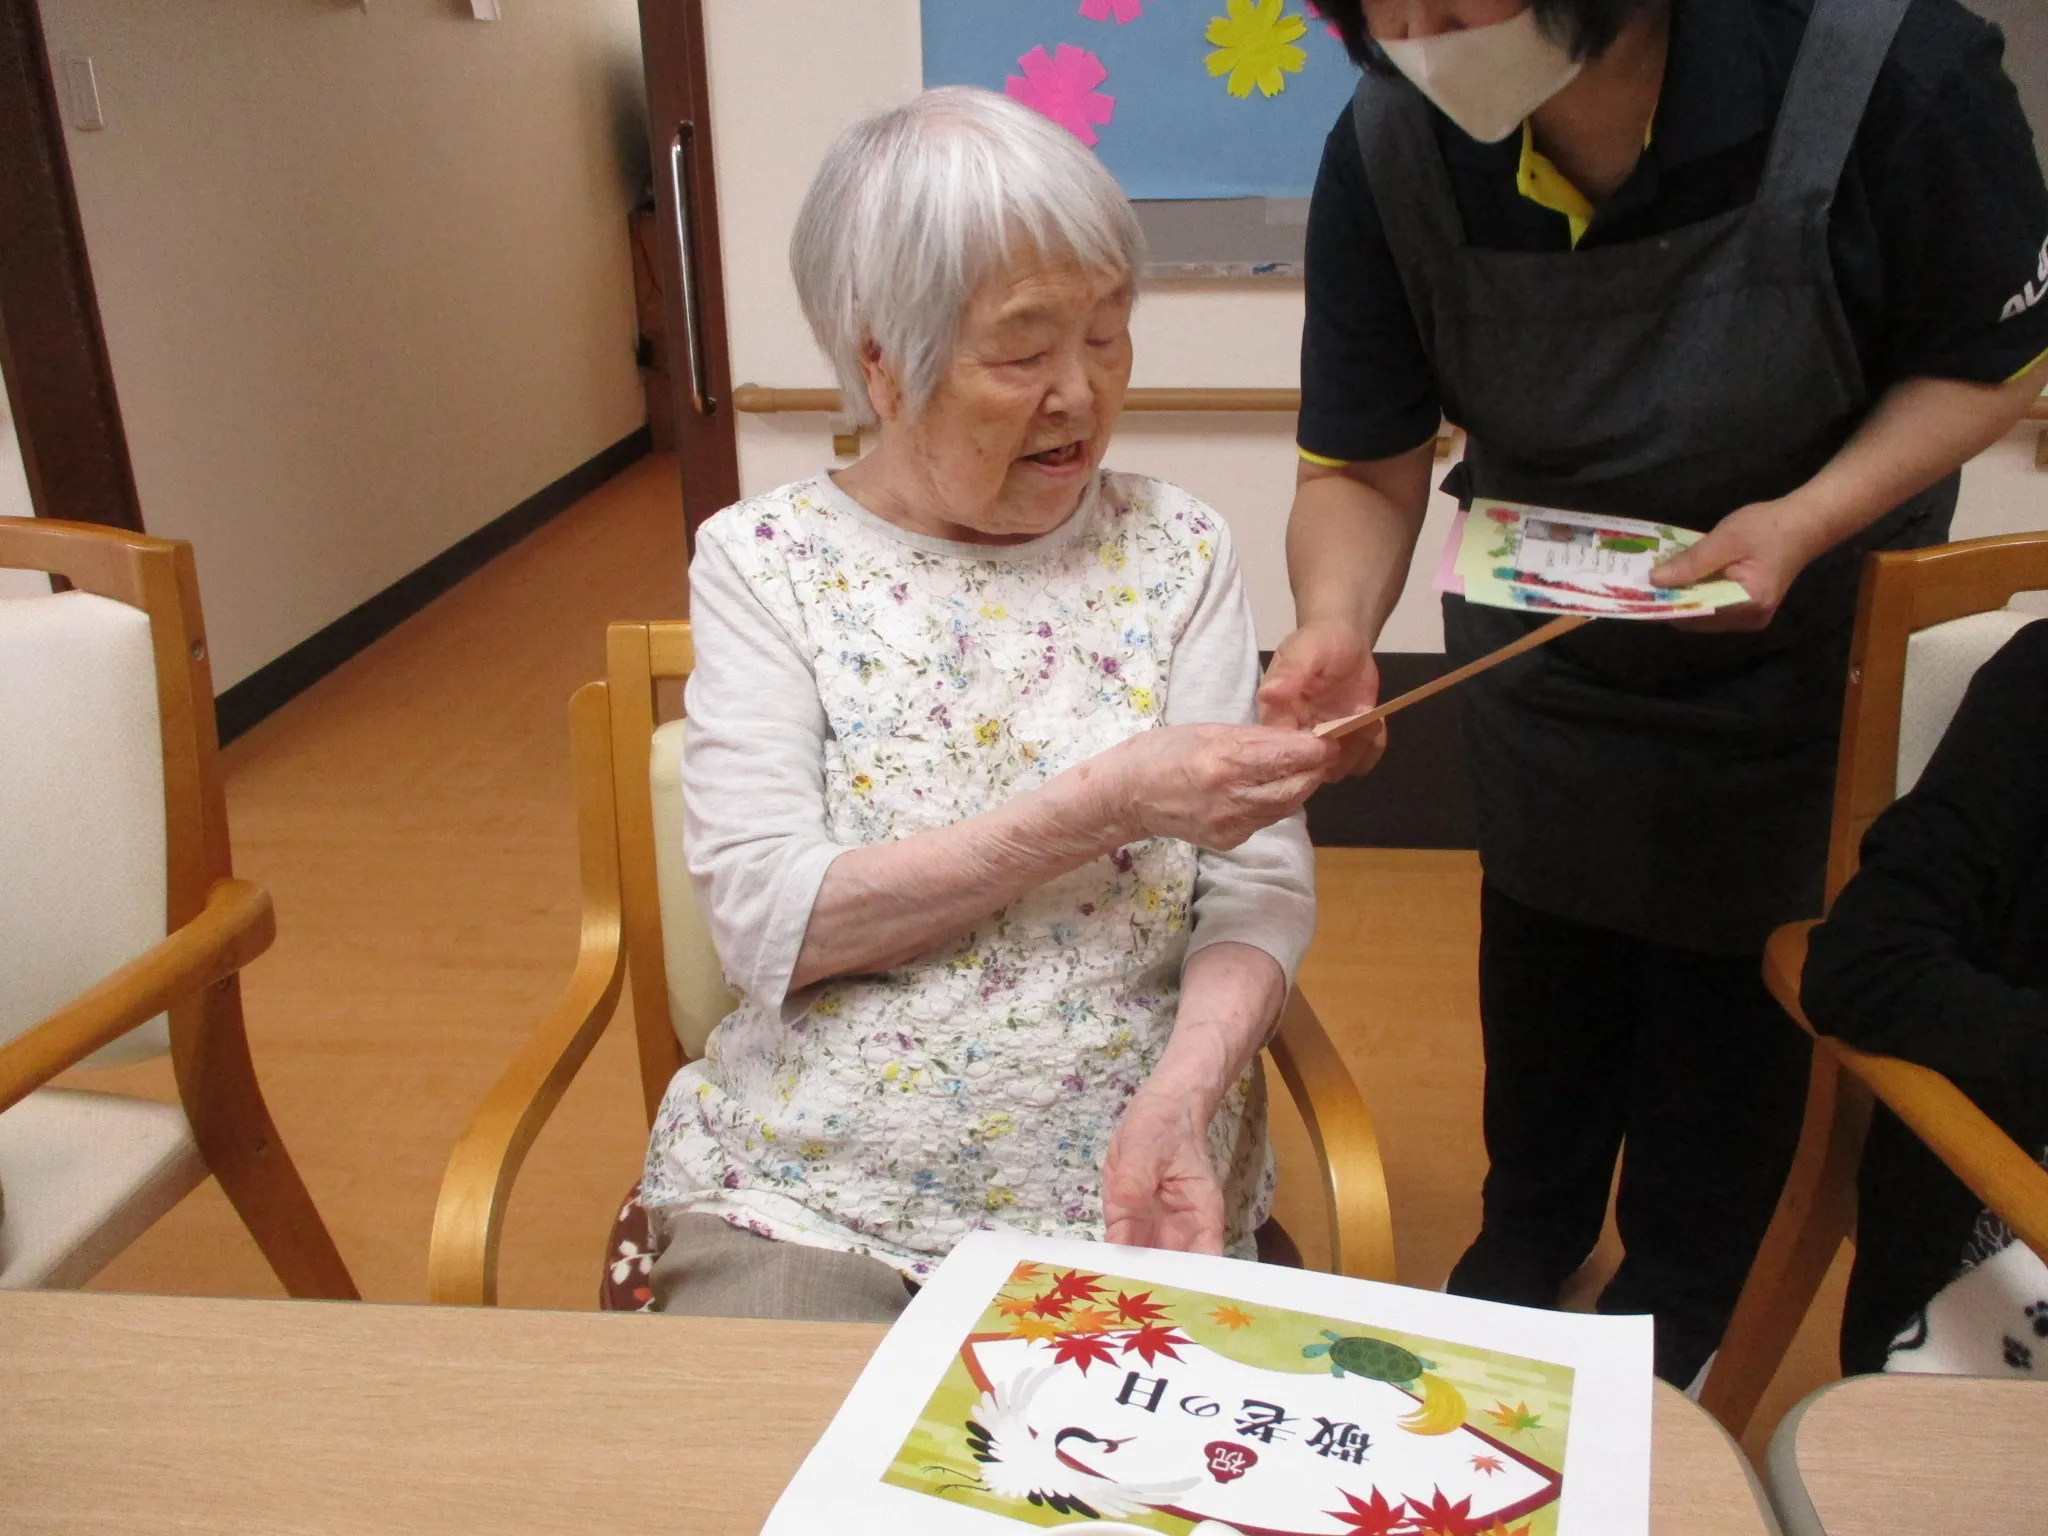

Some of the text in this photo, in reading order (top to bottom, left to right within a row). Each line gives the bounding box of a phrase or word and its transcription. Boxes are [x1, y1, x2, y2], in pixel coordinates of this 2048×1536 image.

[1115, 1371, 1374, 1465] 敬老の日
[1211, 1447, 1247, 1475] 祝
